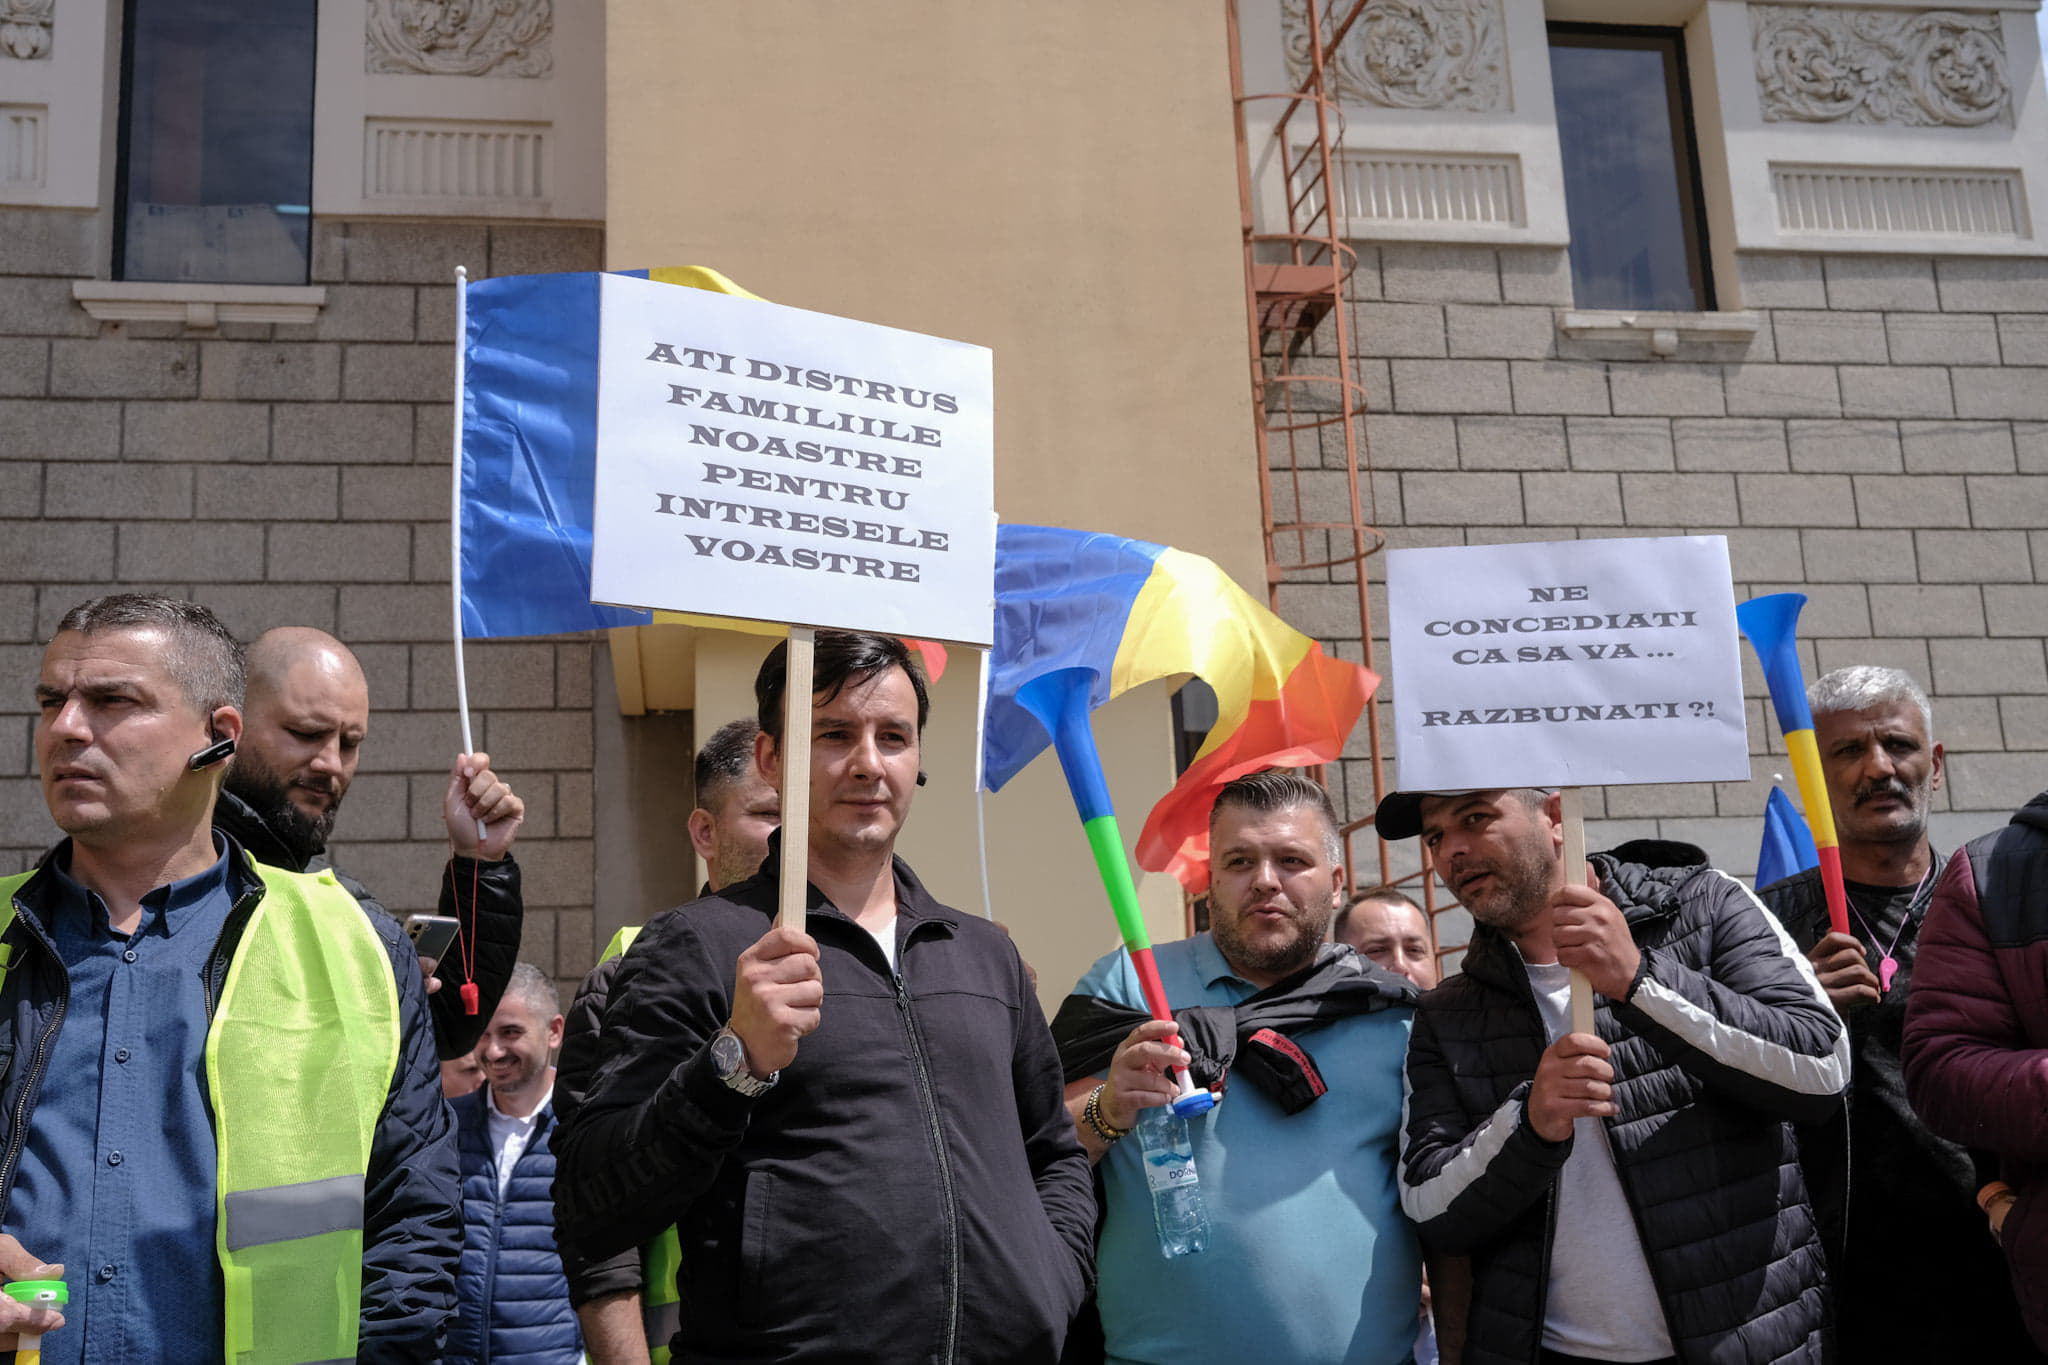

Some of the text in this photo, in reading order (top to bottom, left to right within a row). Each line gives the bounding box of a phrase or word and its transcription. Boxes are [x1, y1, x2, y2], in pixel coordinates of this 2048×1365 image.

[645, 342, 959, 414] ATI DISTRUS
[666, 383, 942, 448] FAMILIILE
[688, 423, 922, 479] NOASTRE
[701, 462, 910, 511] PENTRU
[654, 492, 949, 552] INTRESELE
[684, 534, 920, 583] VOASTRE
[1528, 585, 1589, 603] NE
[1424, 611, 1697, 637] CONCEDIATI
[1452, 648, 1510, 665] CA
[1516, 645, 1574, 663] SA
[1578, 643, 1640, 660] VA
[1421, 702, 1681, 727] RAZBUNATI
